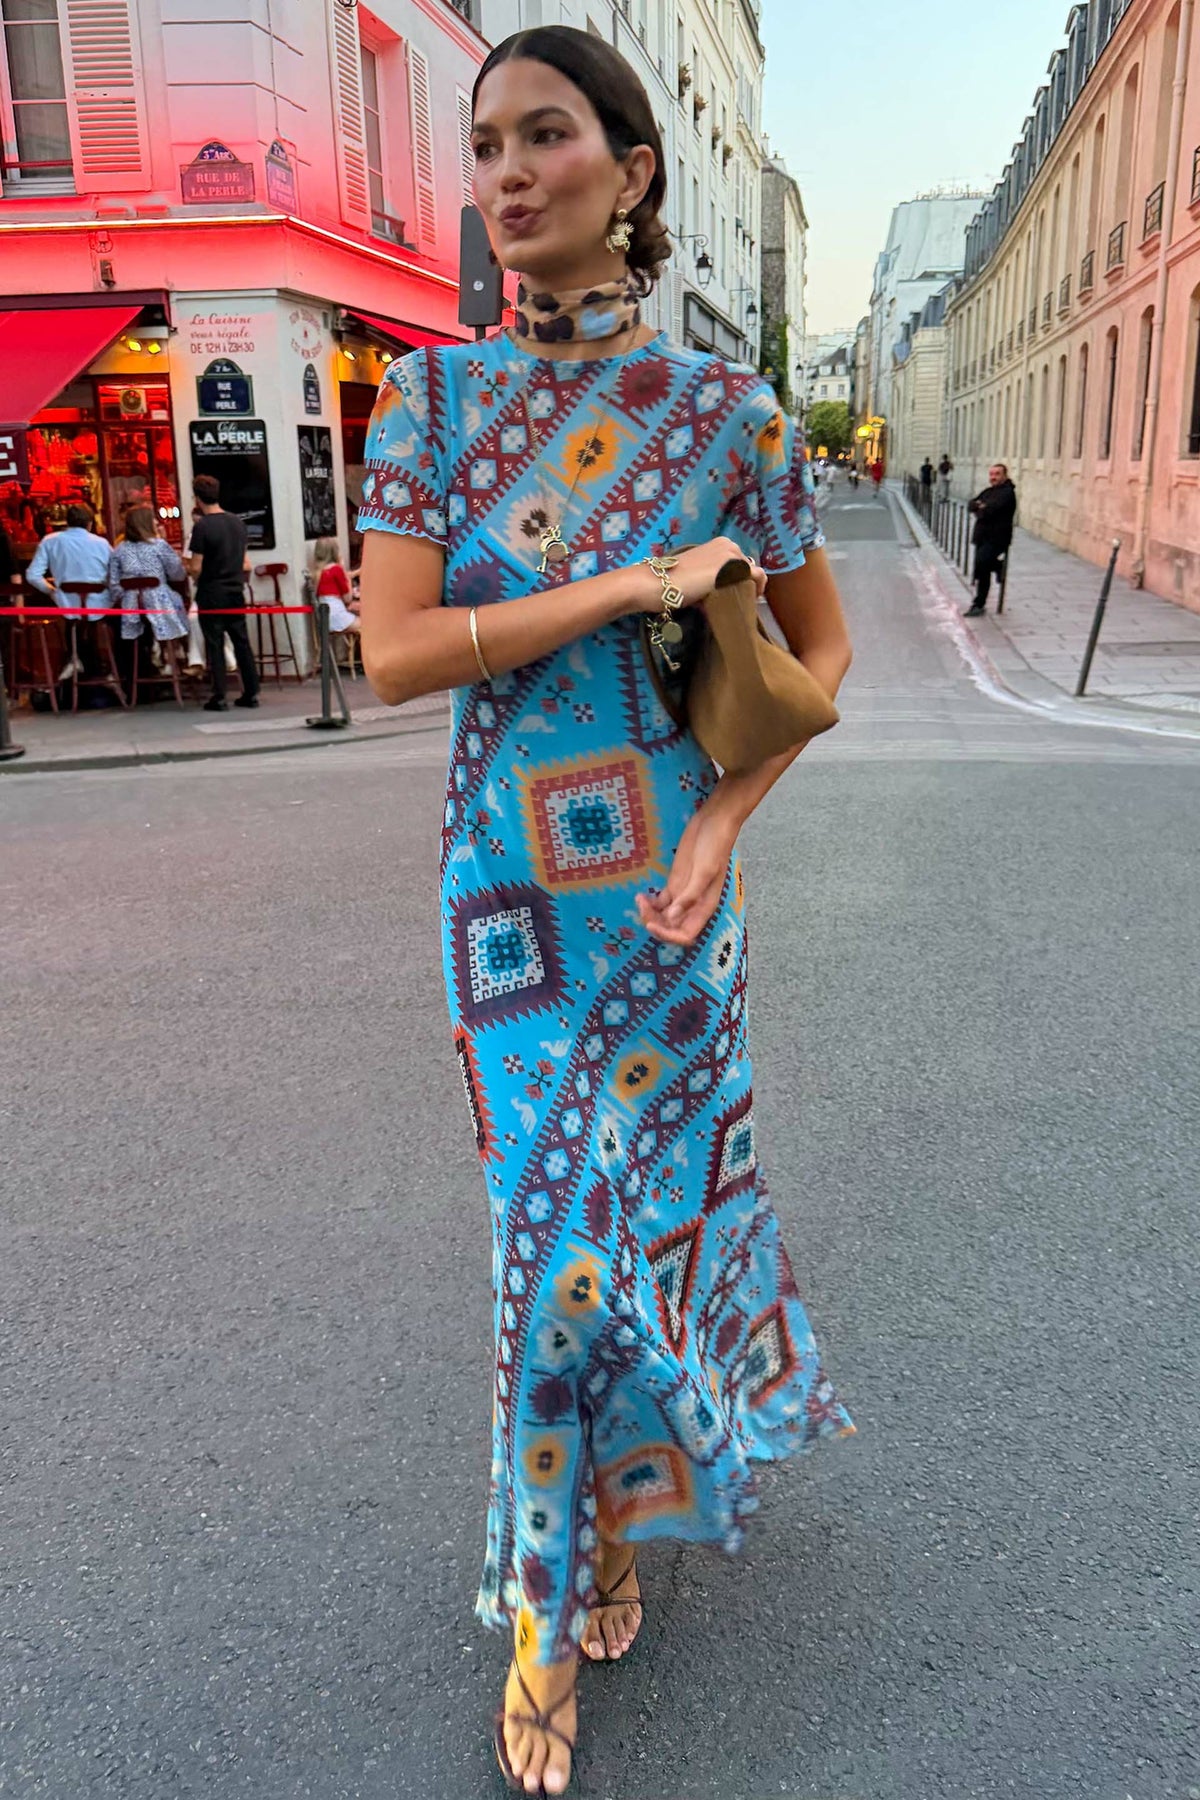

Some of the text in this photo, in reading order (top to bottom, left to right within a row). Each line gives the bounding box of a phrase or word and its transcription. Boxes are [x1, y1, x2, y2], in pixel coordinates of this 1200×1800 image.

[196, 172, 240, 183] RUE DE
[191, 186, 245, 197] LA PERLE
[190, 312, 251, 326] La Cuisine
[190, 331, 213, 339] vous
[190, 343, 203, 354] DE
[205, 342, 221, 354] 12H
[217, 381, 232, 391] RUE
[215, 401, 237, 410] PERLE
[192, 430, 264, 444] LA PERLE
